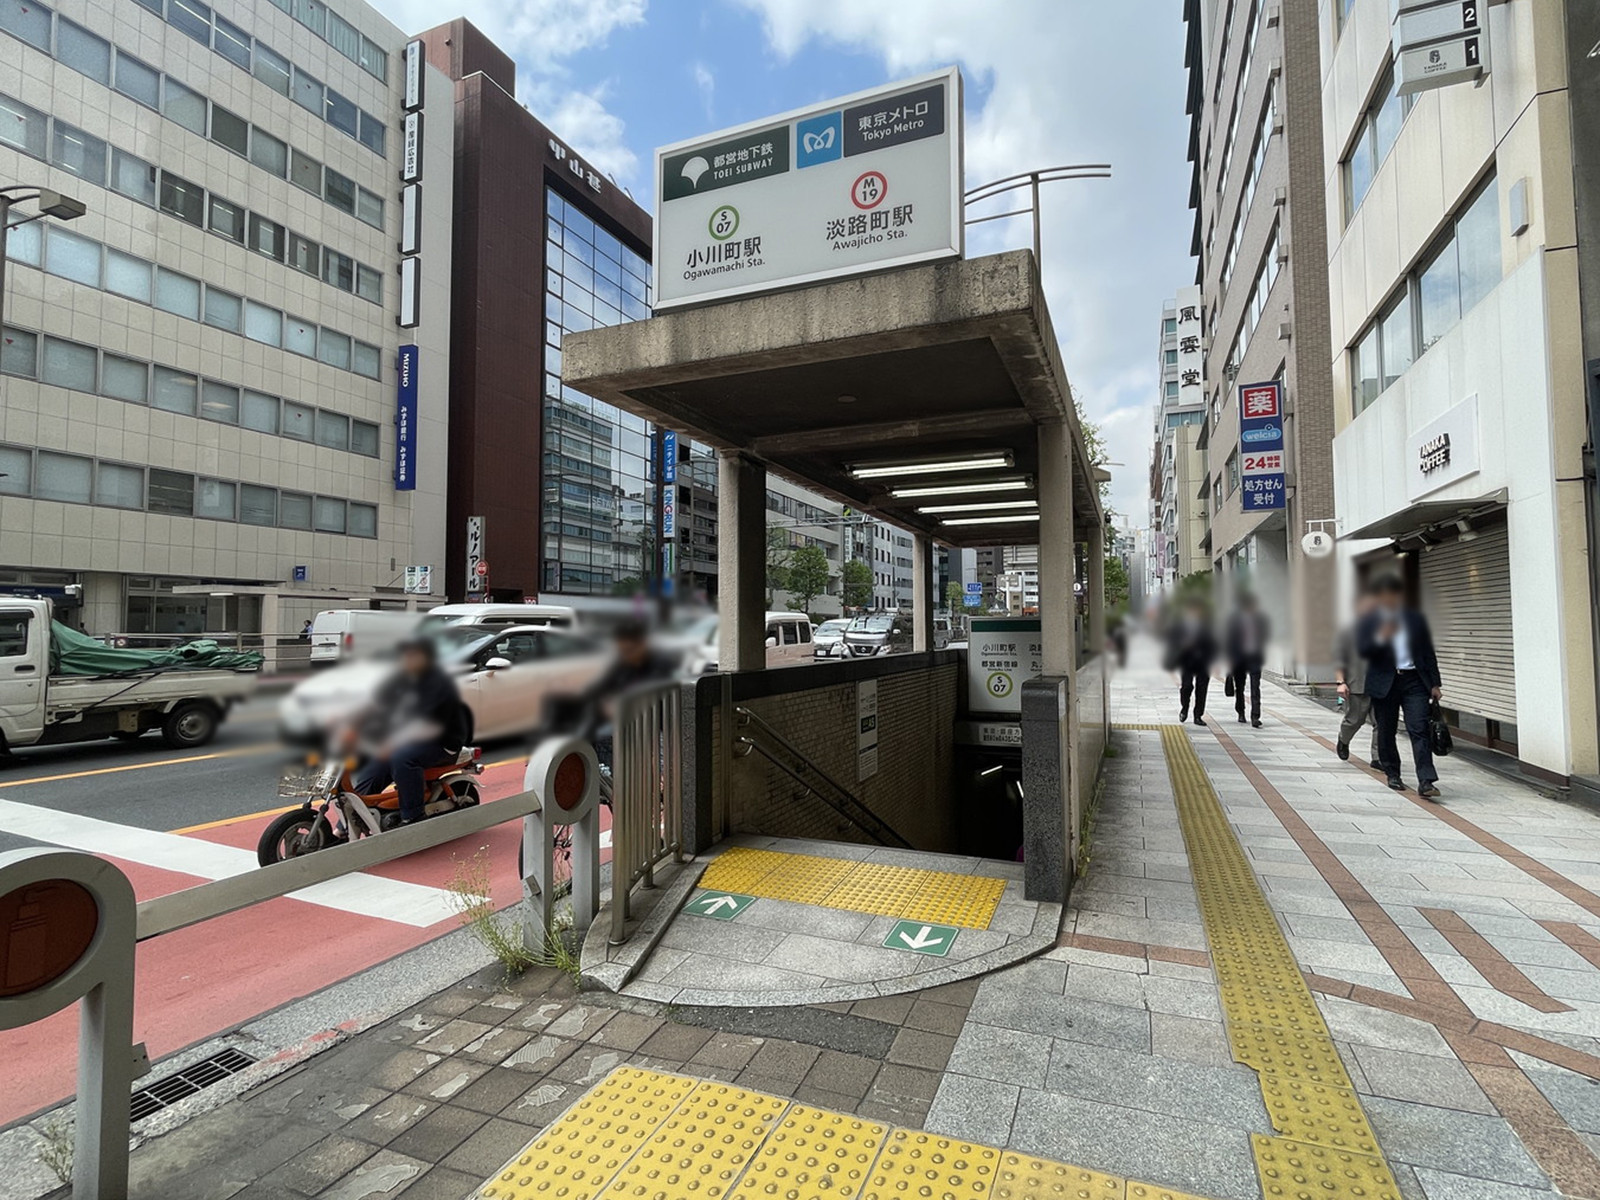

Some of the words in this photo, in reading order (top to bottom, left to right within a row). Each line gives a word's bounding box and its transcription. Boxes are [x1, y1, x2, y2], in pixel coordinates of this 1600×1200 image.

[1465, 8, 1475, 22] 2
[1469, 45, 1476, 59] 1
[858, 101, 928, 131] 東京メトロ
[862, 127, 891, 142] Tokyo
[893, 119, 924, 134] Metro
[713, 142, 773, 168] 都営地下鉄
[714, 168, 733, 180] TOEI
[735, 157, 774, 175] SUBWAY
[863, 177, 875, 189] M
[862, 188, 878, 201] 19
[720, 211, 728, 221] S
[826, 204, 913, 240] 淡路町駅
[716, 221, 732, 234] 07
[832, 233, 884, 251] Awajicho
[886, 229, 908, 241] Sta.
[686, 236, 761, 269] 小川町駅
[683, 260, 745, 281] Ogawamachi
[747, 257, 766, 268] Sta.
[1178, 306, 1200, 388] 風雲堂
[1247, 390, 1273, 414] 薬
[1245, 431, 1277, 441] welcia
[1245, 457, 1266, 470] 24
[1420, 448, 1447, 472] COFFEE
[1244, 478, 1283, 492] 処方せん
[1253, 493, 1275, 506] 受付
[664, 489, 673, 534] KINGRUN
[469, 531, 480, 589] ルノアール
[982, 643, 1017, 652] 小川町駅
[993, 684, 1006, 692] 07
[997, 676, 1003, 684] S
